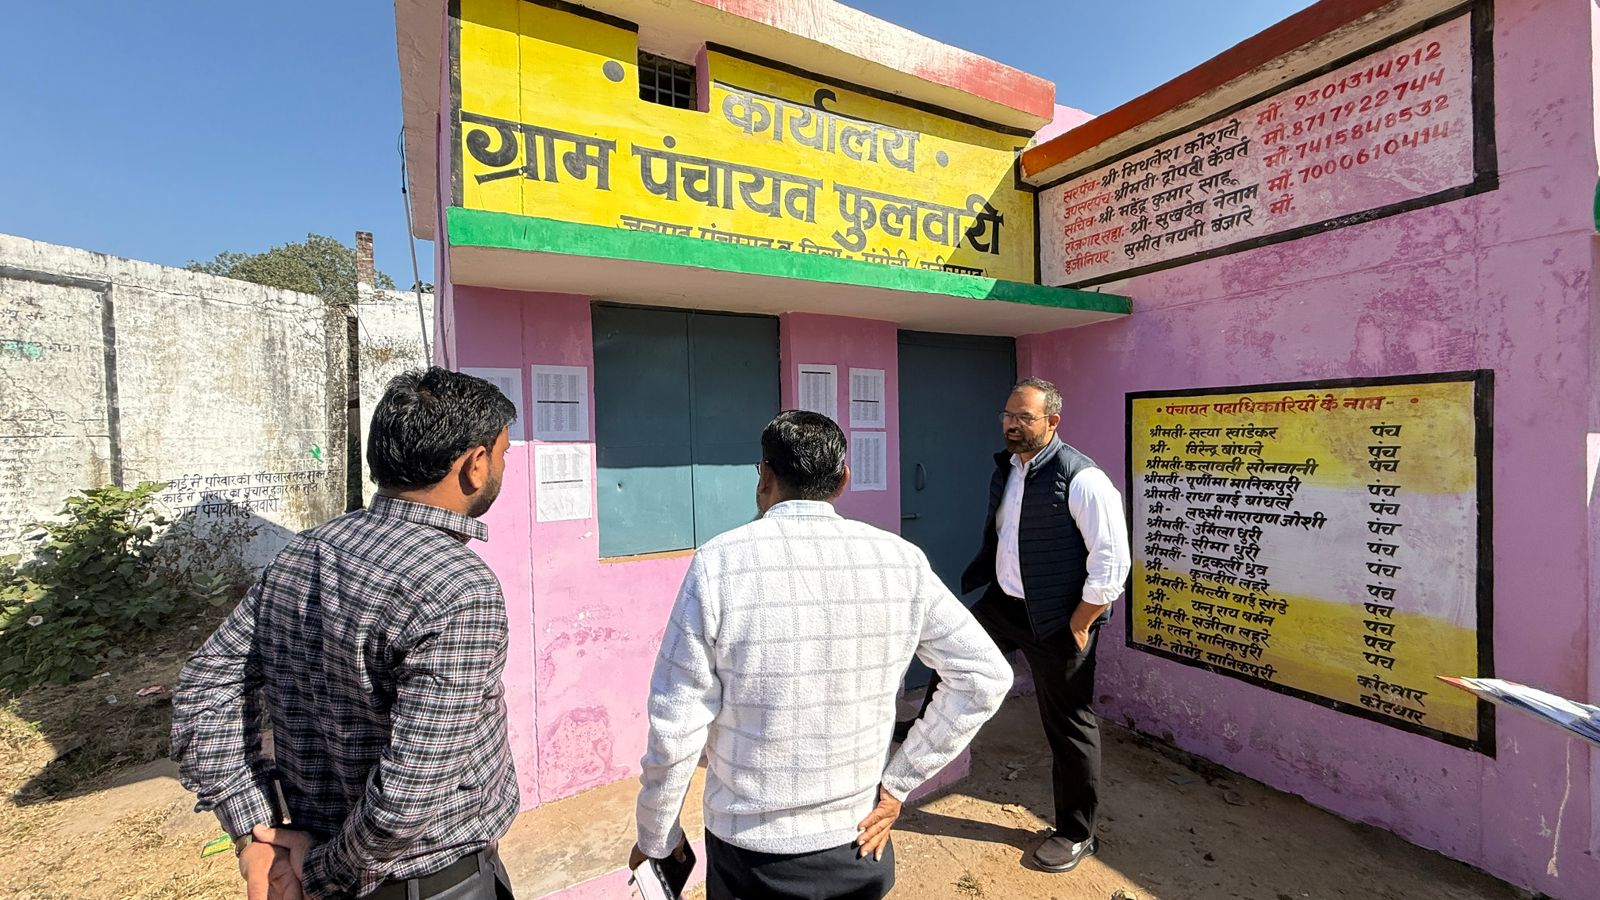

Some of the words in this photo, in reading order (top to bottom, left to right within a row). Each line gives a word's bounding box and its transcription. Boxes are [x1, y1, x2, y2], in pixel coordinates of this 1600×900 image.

[1122, 149, 1181, 179] मिथलेश
[1184, 118, 1241, 154] कोशले
[1295, 41, 1441, 111] 9301314912
[1292, 67, 1445, 136] 8717922744
[714, 80, 921, 172] कार्यालय
[1152, 182, 1195, 211] कुमार
[1199, 169, 1240, 194] साहू
[1296, 94, 1449, 158] 7415848532
[460, 110, 617, 191] ग्राम
[632, 135, 823, 224] पंचायत
[833, 181, 1004, 256] फुलवारी
[1155, 200, 1206, 229] सुखदेव
[1213, 184, 1260, 209] नेताम
[1298, 121, 1449, 183] 7000610414
[1124, 234, 1163, 260] सुमीत
[1165, 220, 1206, 244] नयनी
[1211, 205, 1254, 233] बंजारे
[1165, 403, 1210, 417] पंचायत
[1213, 394, 1320, 416] पदाधिकारियों
[1320, 394, 1338, 411] के
[1369, 422, 1402, 437] पंच
[1221, 441, 1264, 458] बांधले
[1367, 441, 1401, 458] पंच
[1184, 457, 1244, 476] कलावती
[1246, 458, 1319, 476] सोनवानी
[1368, 458, 1400, 472] पंच
[1229, 475, 1302, 496] मानिकपुरी
[1367, 479, 1401, 497] पंच
[1185, 491, 1215, 504] राधा
[1216, 490, 1242, 508] बाई
[1245, 491, 1294, 511] बांधले
[1369, 499, 1400, 515] पंच
[1185, 504, 1224, 521] लक्ष्मी
[1224, 510, 1281, 525] नारायण
[1280, 511, 1327, 530] जोशी
[1367, 517, 1402, 535] पंच
[1193, 521, 1236, 539] उर्मिला
[1237, 525, 1263, 544] धुरी
[1191, 536, 1229, 553] सीमा
[1234, 543, 1261, 562] धुरी
[1367, 538, 1399, 557] पंच
[1366, 558, 1402, 578] पंच
[1189, 568, 1237, 585] कुलदीप
[1238, 578, 1270, 596] लहरे
[1366, 581, 1397, 601] पंच
[1216, 605, 1240, 619] राय
[1232, 592, 1257, 609] बाई
[1258, 598, 1289, 615] सांडे
[1364, 599, 1395, 619] पंच
[1363, 617, 1395, 637] पंच
[1167, 623, 1193, 639] रतन
[1196, 631, 1263, 660] मानिकपुरी
[1239, 628, 1271, 648] लहरे
[1363, 634, 1396, 652] पंच
[1362, 649, 1396, 671] पंच
